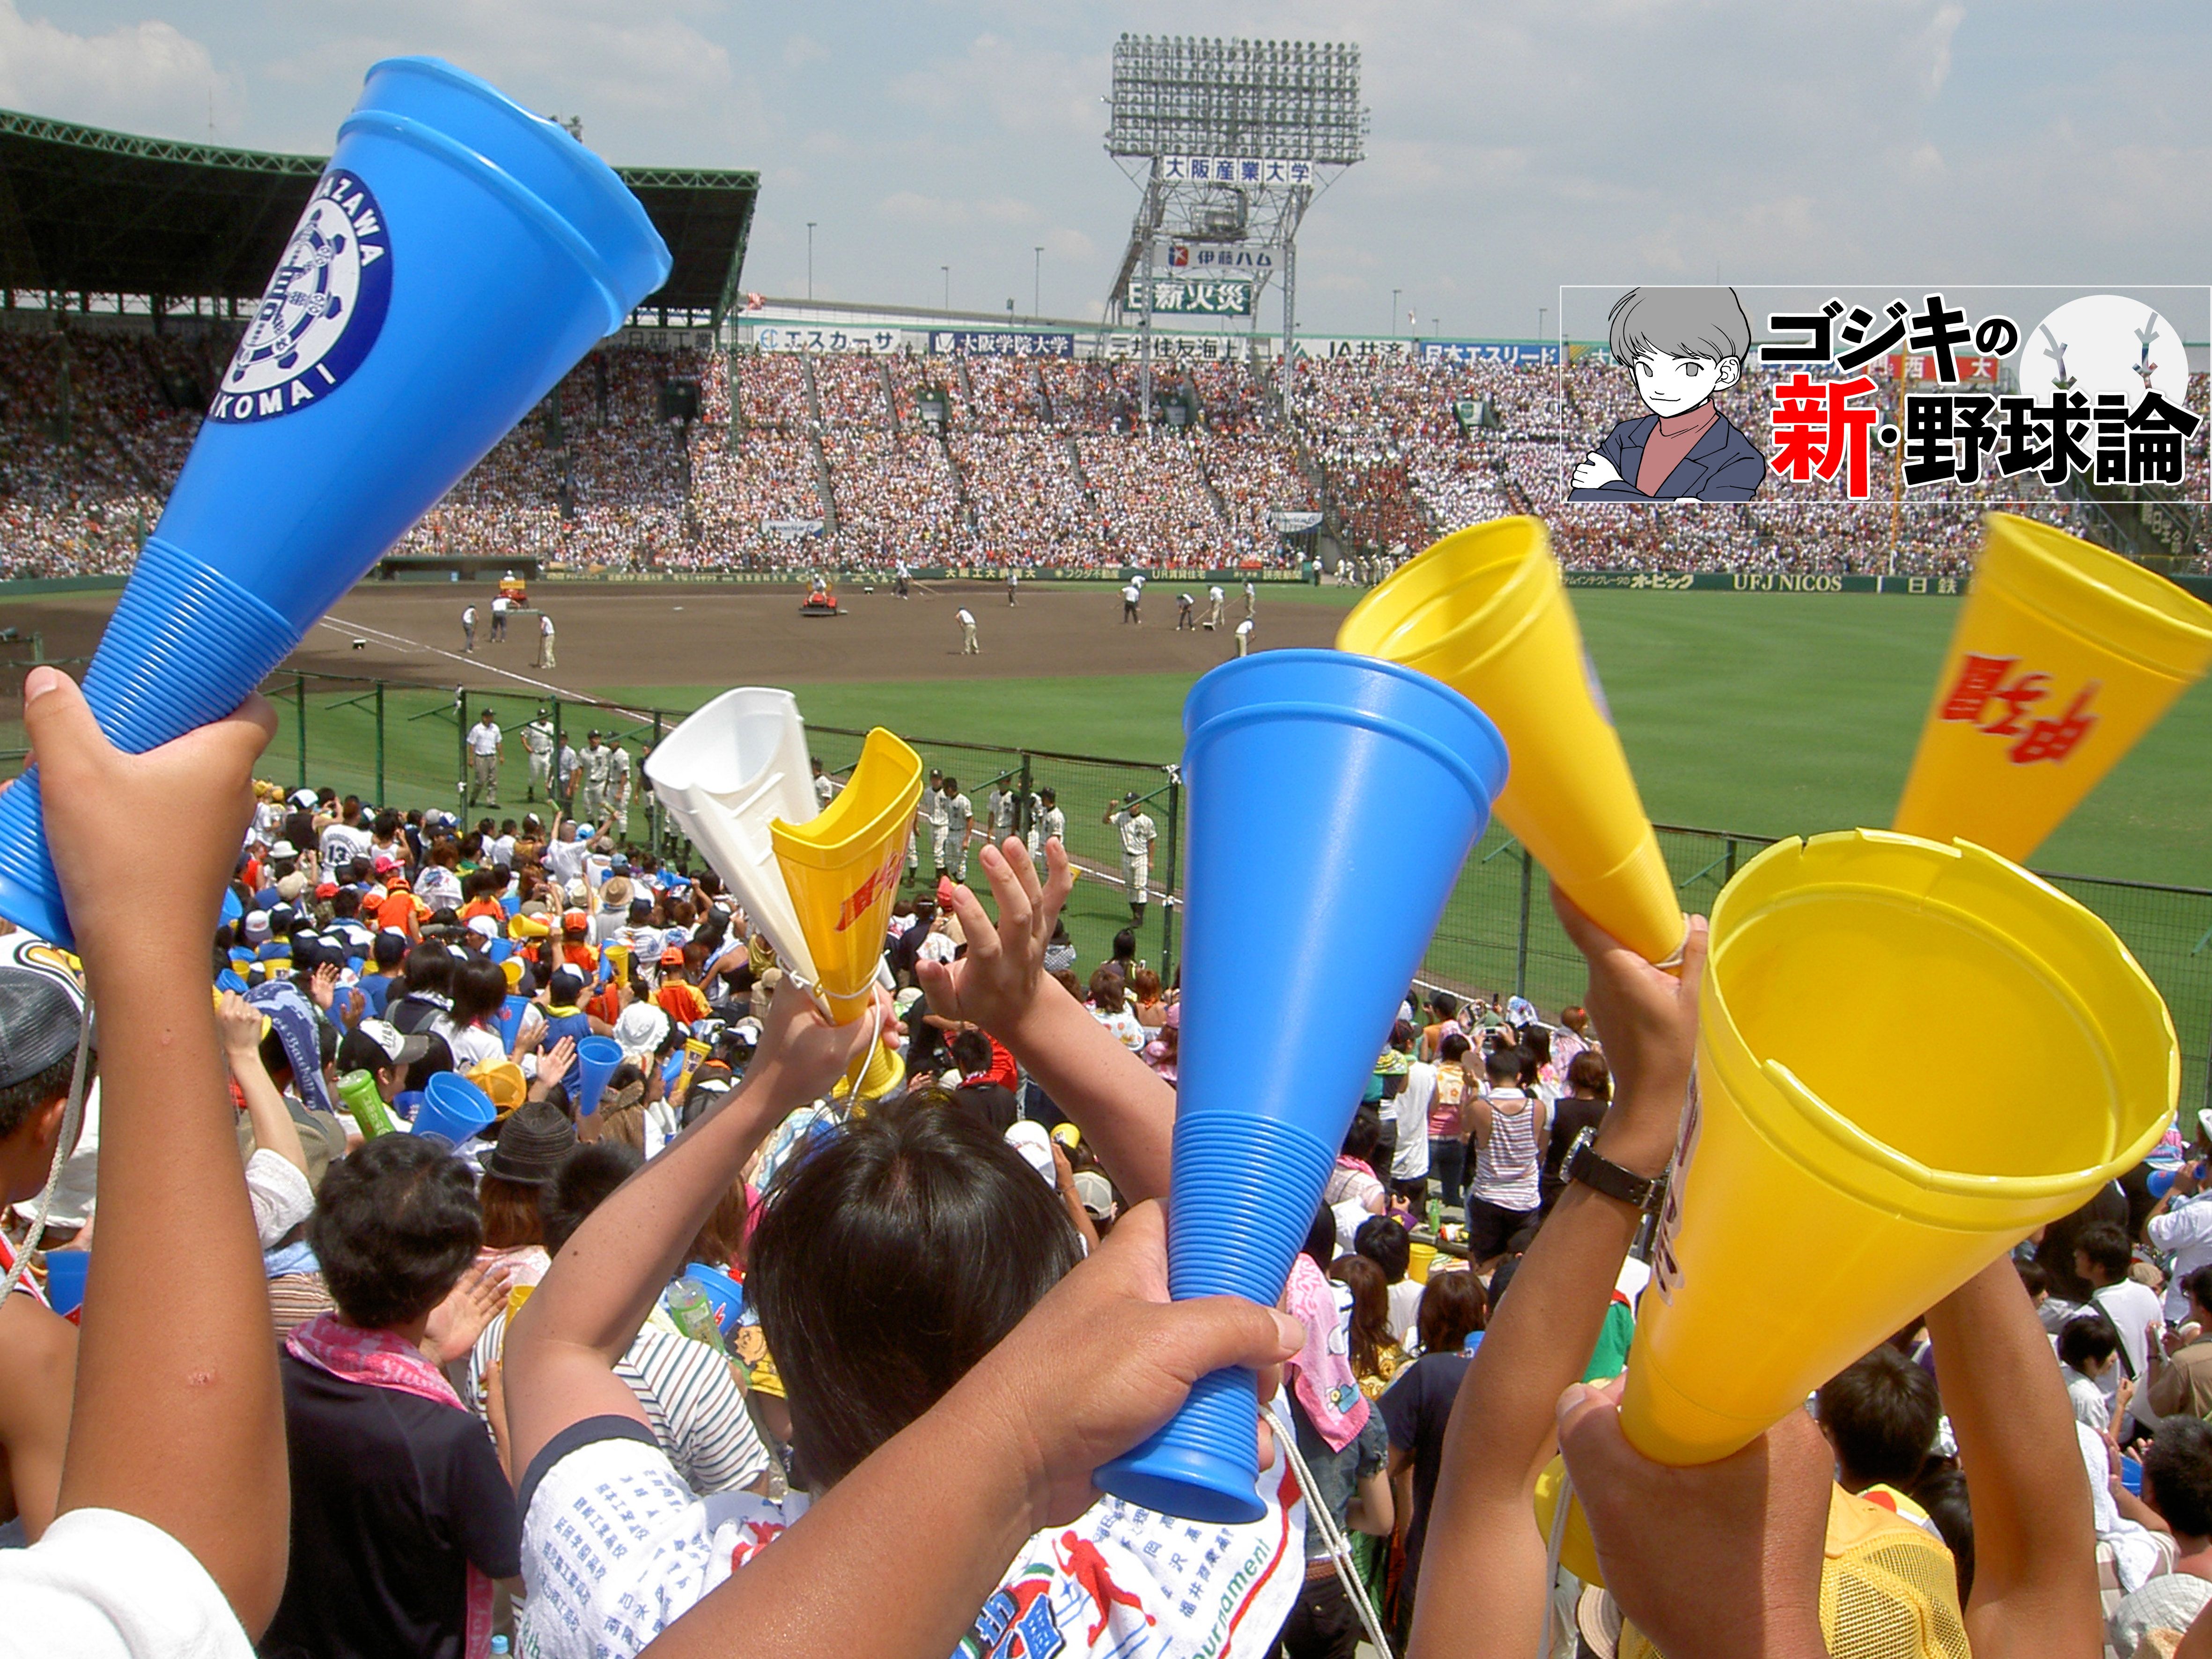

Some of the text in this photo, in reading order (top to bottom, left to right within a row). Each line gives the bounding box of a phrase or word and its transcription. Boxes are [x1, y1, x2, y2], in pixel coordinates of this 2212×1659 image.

[1165, 157, 1311, 182] 大阪産業大学
[1197, 251, 1272, 266] 伊藤ハム
[960, 333, 1070, 354] 大阪学院大学
[210, 364, 336, 419] KOMAI
[1733, 574, 1843, 591] UFJ NICOS
[1192, 1536, 1271, 1659] urnament
